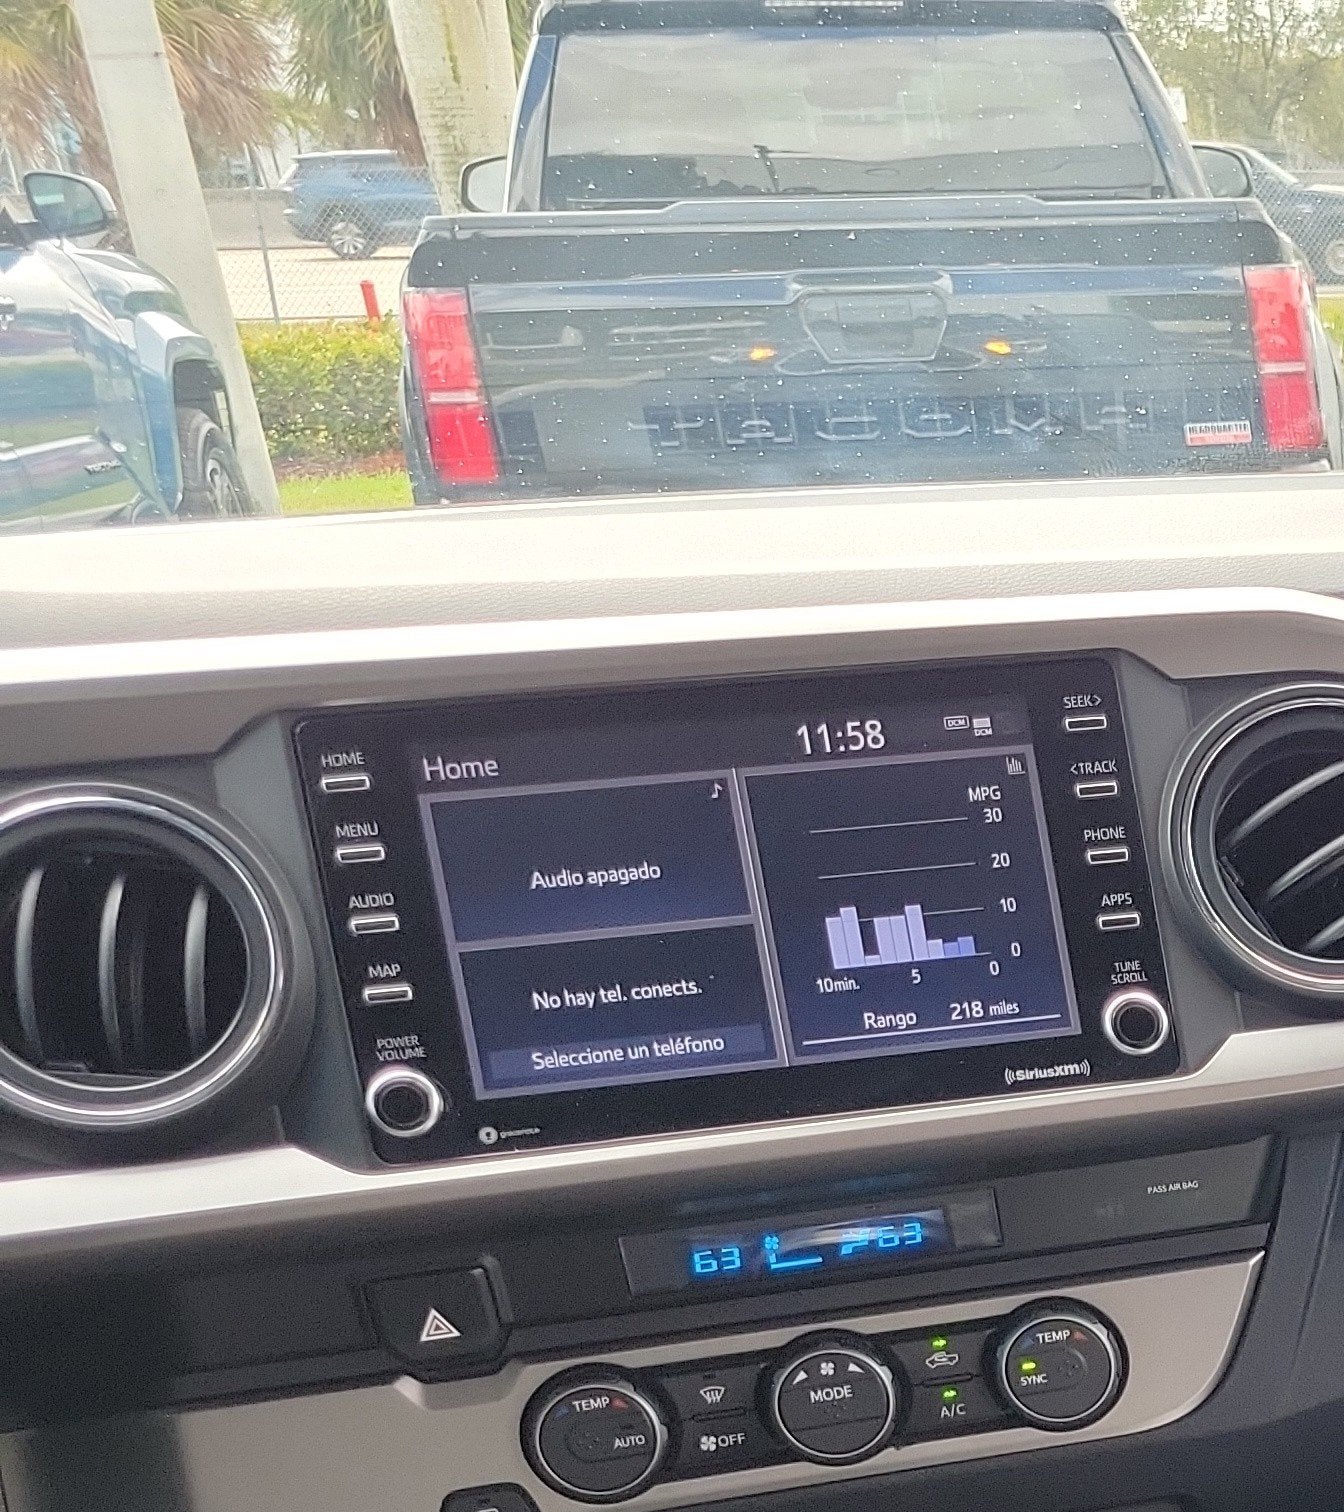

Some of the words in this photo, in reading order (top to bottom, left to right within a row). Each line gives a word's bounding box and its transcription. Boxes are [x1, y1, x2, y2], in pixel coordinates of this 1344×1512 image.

[796, 718, 886, 756] 11:58
[321, 751, 366, 768] HOME
[423, 756, 500, 782] Home
[968, 785, 1002, 803] MPG
[983, 807, 1003, 824] 30
[335, 822, 380, 838] MENU
[1083, 825, 1127, 842] PHONE
[991, 852, 1011, 869] 20
[530, 868, 584, 890] Audio
[586, 861, 662, 887] apagado
[348, 891, 395, 909] AUDIO
[1000, 897, 1018, 914] 10
[1101, 891, 1134, 907] APPS
[1010, 941, 1022, 958] 0
[368, 962, 402, 979] MAP
[1113, 960, 1141, 972] TUNE
[816, 975, 861, 994] 10min.
[911, 968, 922, 986] 5
[989, 960, 1000, 976] 0
[1110, 971, 1148, 985] SCROLL
[532, 990, 561, 1011] No
[563, 987, 597, 1010] hay
[600, 984, 629, 1004] tel.
[631, 979, 704, 1001] conects.
[863, 1009, 918, 1032] Rango
[950, 1001, 985, 1021] 218
[988, 999, 1021, 1016] miles
[376, 1035, 420, 1049] POWER
[375, 1046, 428, 1061] VOLUME
[531, 1046, 625, 1071] Seleccione
[628, 1044, 651, 1061] un
[652, 1034, 726, 1058] teléfono
[1147, 1184, 1167, 1194] PASS
[1168, 1182, 1181, 1192] AIR
[1182, 1180, 1199, 1190] BAG
[876, 1222, 925, 1250] 63
[692, 1246, 742, 1275] 63
[1036, 1329, 1072, 1345] TEMP
[1019, 1373, 1048, 1387] SYNC
[809, 1384, 854, 1404] MODE
[572, 1395, 611, 1415] TEMP
[939, 1402, 967, 1419] A/C
[613, 1433, 646, 1450] AUTO
[717, 1432, 747, 1449] OFF
